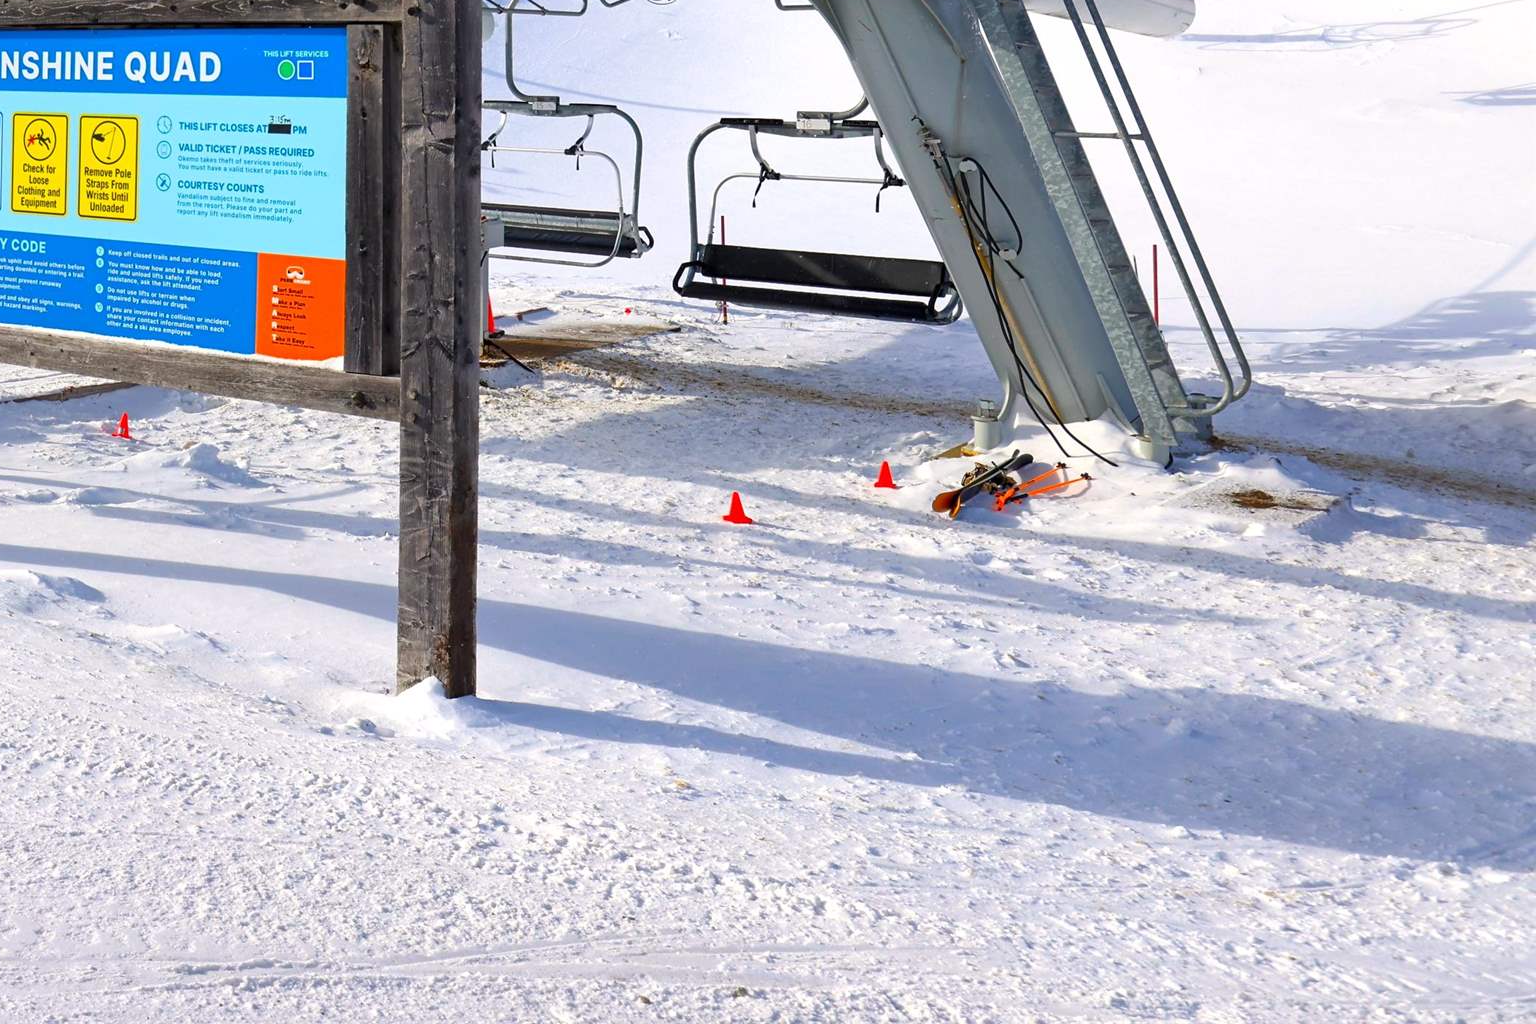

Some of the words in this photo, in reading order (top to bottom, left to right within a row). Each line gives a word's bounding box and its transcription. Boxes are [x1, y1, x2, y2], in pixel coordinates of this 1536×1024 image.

[124, 51, 222, 83] QUAD
[179, 122, 198, 130] THIS
[200, 123, 217, 131] LIFT
[220, 124, 254, 133] CLOSES
[256, 125, 267, 134] AT
[293, 126, 307, 134] PM
[178, 144, 203, 152] VALID
[205, 145, 237, 154] TICKET
[238, 146, 242, 154] /
[244, 146, 267, 155] PASS
[269, 148, 315, 157] REQUIRED
[23, 163, 44, 173] Check
[46, 165, 56, 174] for
[85, 167, 112, 177] Remove
[115, 169, 131, 178] Pole
[29, 176, 49, 184] Loose
[86, 179, 109, 189] Straps
[112, 180, 129, 190] From
[18, 185, 45, 198] Clothing
[48, 188, 60, 197] and
[178, 180, 224, 191] COURTESY
[227, 183, 264, 193] COUNTS
[86, 191, 109, 200] Wrists
[112, 192, 128, 201] Until
[210, 195, 233, 203] subject
[270, 198, 296, 206] removal
[21, 197, 57, 208] Equipment
[90, 203, 124, 213] Unloaded
[227, 203, 247, 211] Please
[253, 214, 294, 224] immediately.
[11, 238, 46, 253] CODE
